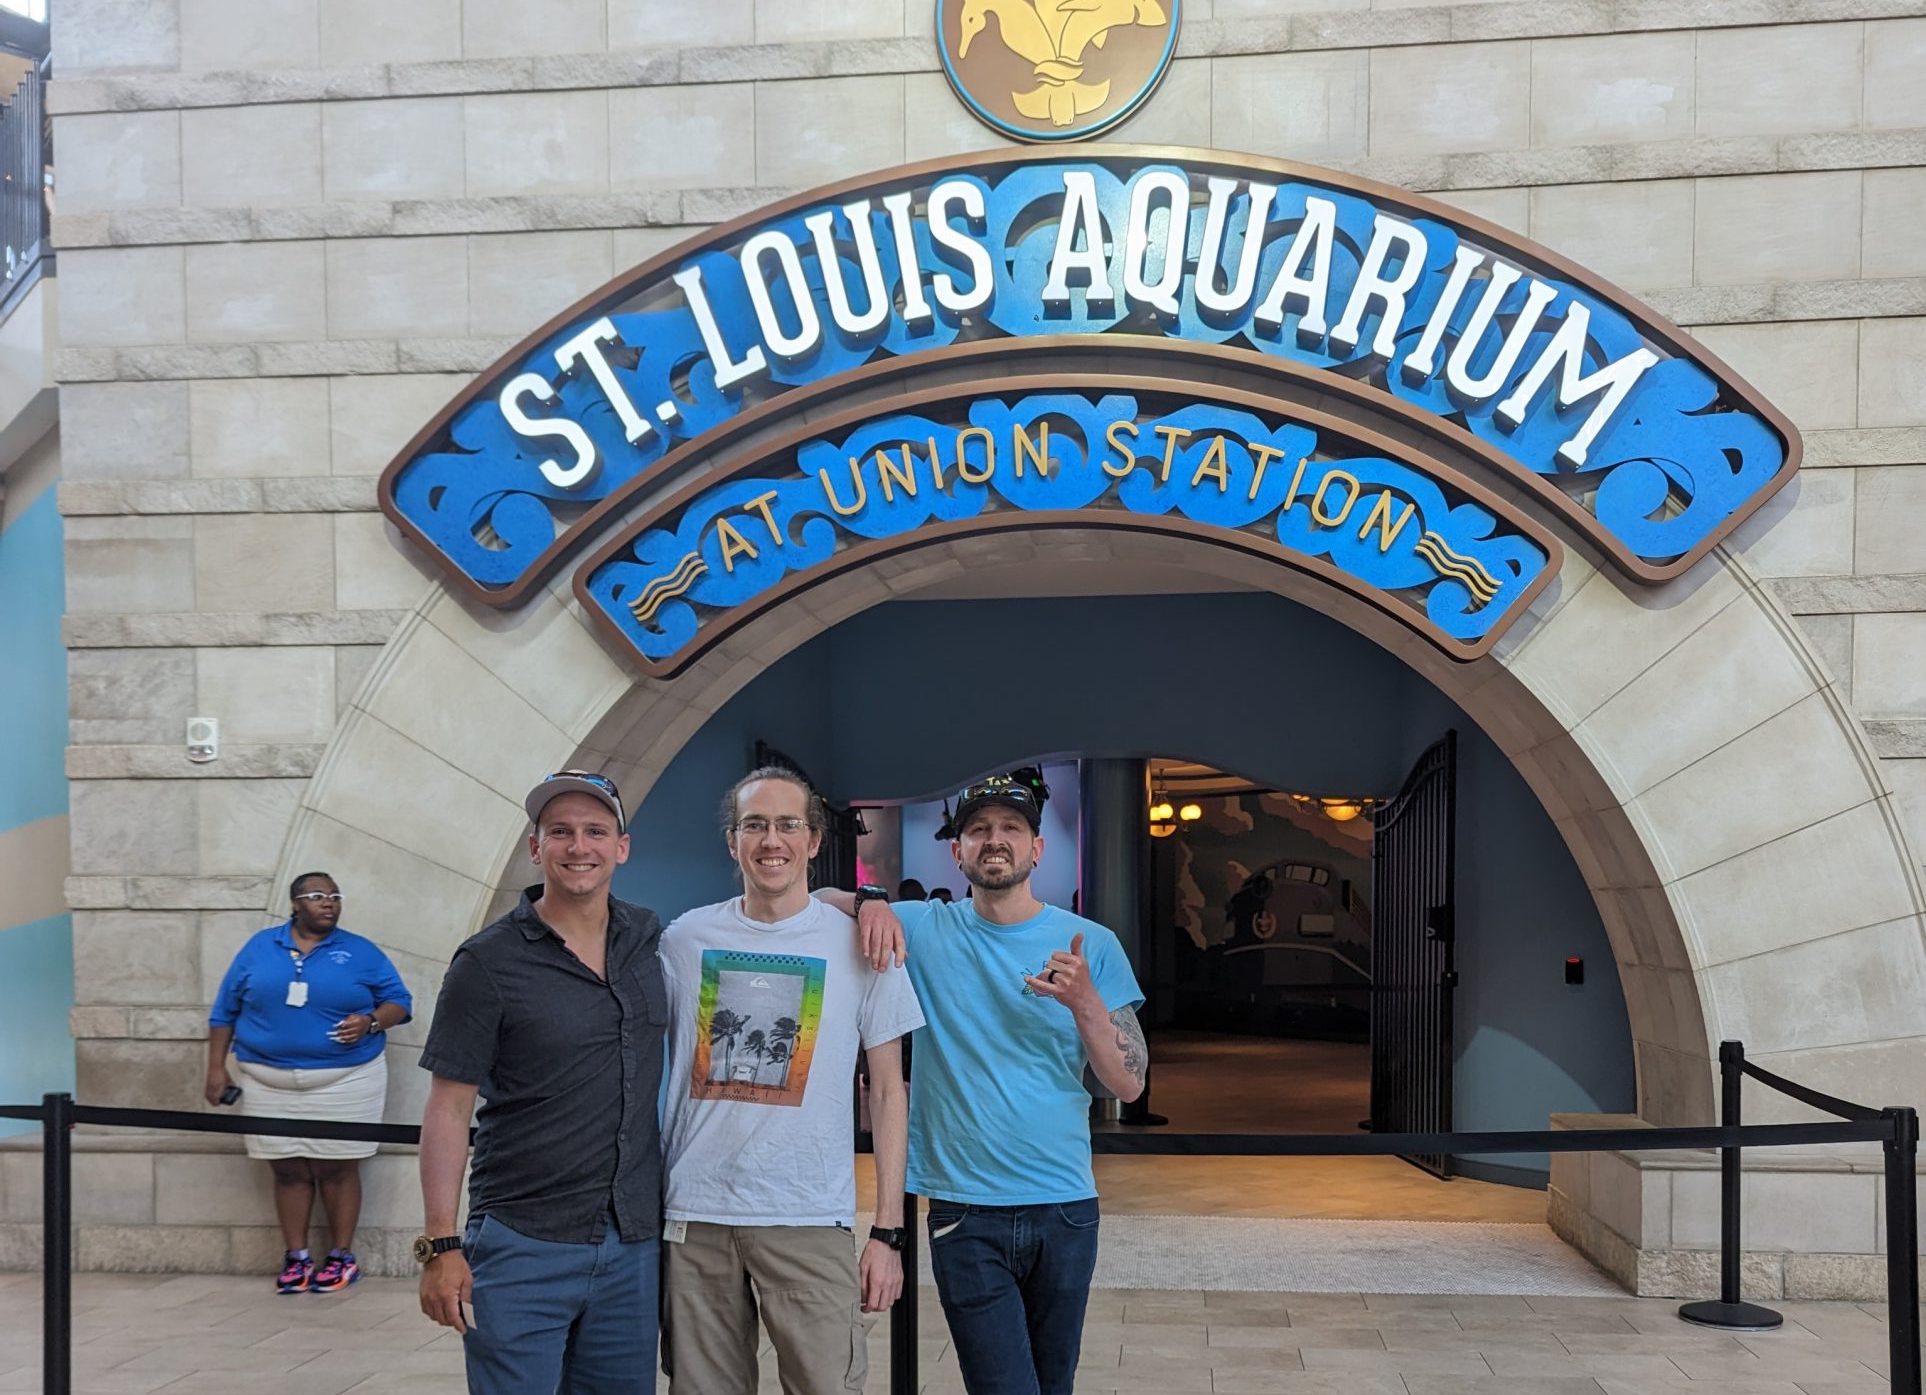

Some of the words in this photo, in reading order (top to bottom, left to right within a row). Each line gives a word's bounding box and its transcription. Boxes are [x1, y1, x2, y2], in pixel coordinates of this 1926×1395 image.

[499, 317, 679, 488] ST.
[673, 181, 995, 389] LOUIS
[1042, 171, 1660, 466] AQUARIUM
[716, 489, 783, 573] AT
[819, 421, 1049, 516] UNION
[1101, 419, 1416, 553] STATION
